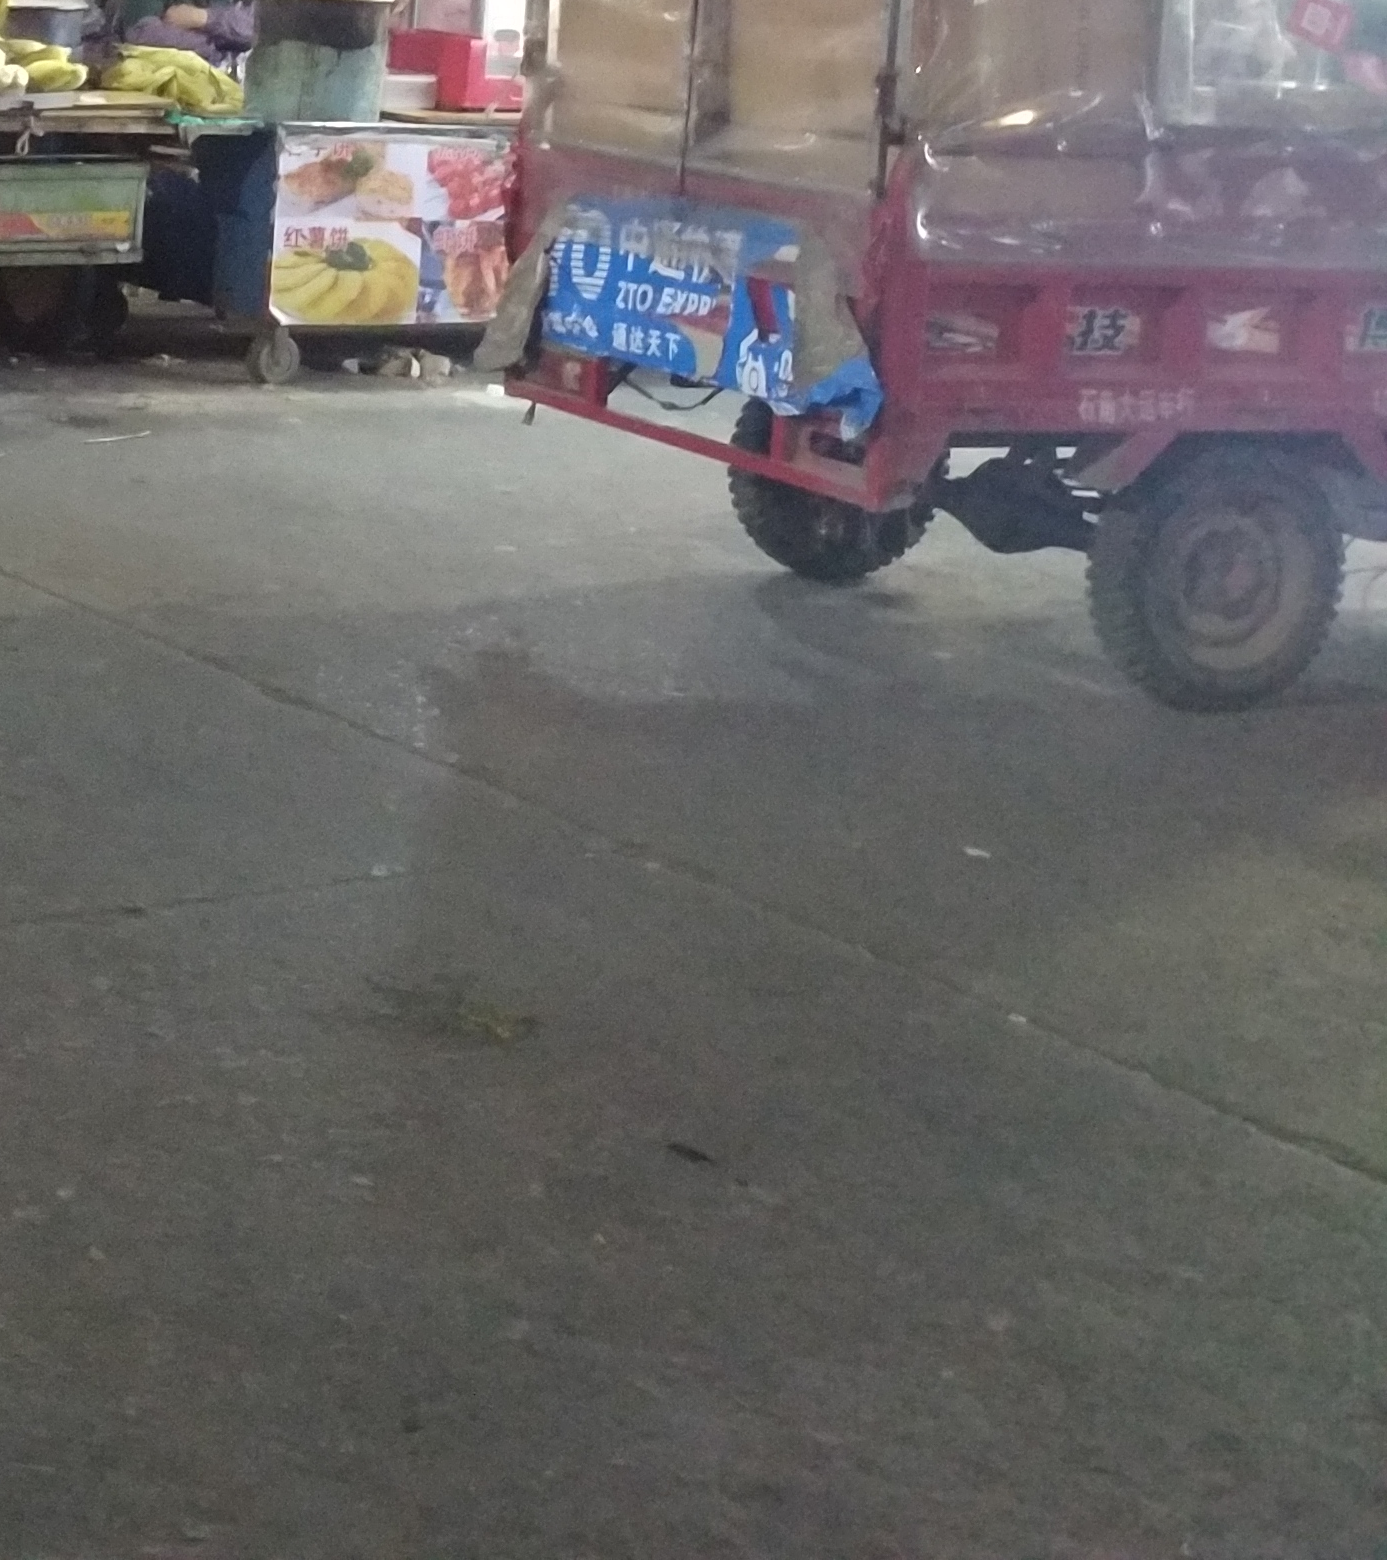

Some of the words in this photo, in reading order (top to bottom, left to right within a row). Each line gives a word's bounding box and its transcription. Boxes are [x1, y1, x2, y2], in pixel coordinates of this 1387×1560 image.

[283, 226, 348, 251] 红薯饼
[616, 280, 654, 313] ZTO
[612, 322, 681, 362] 通达天下
